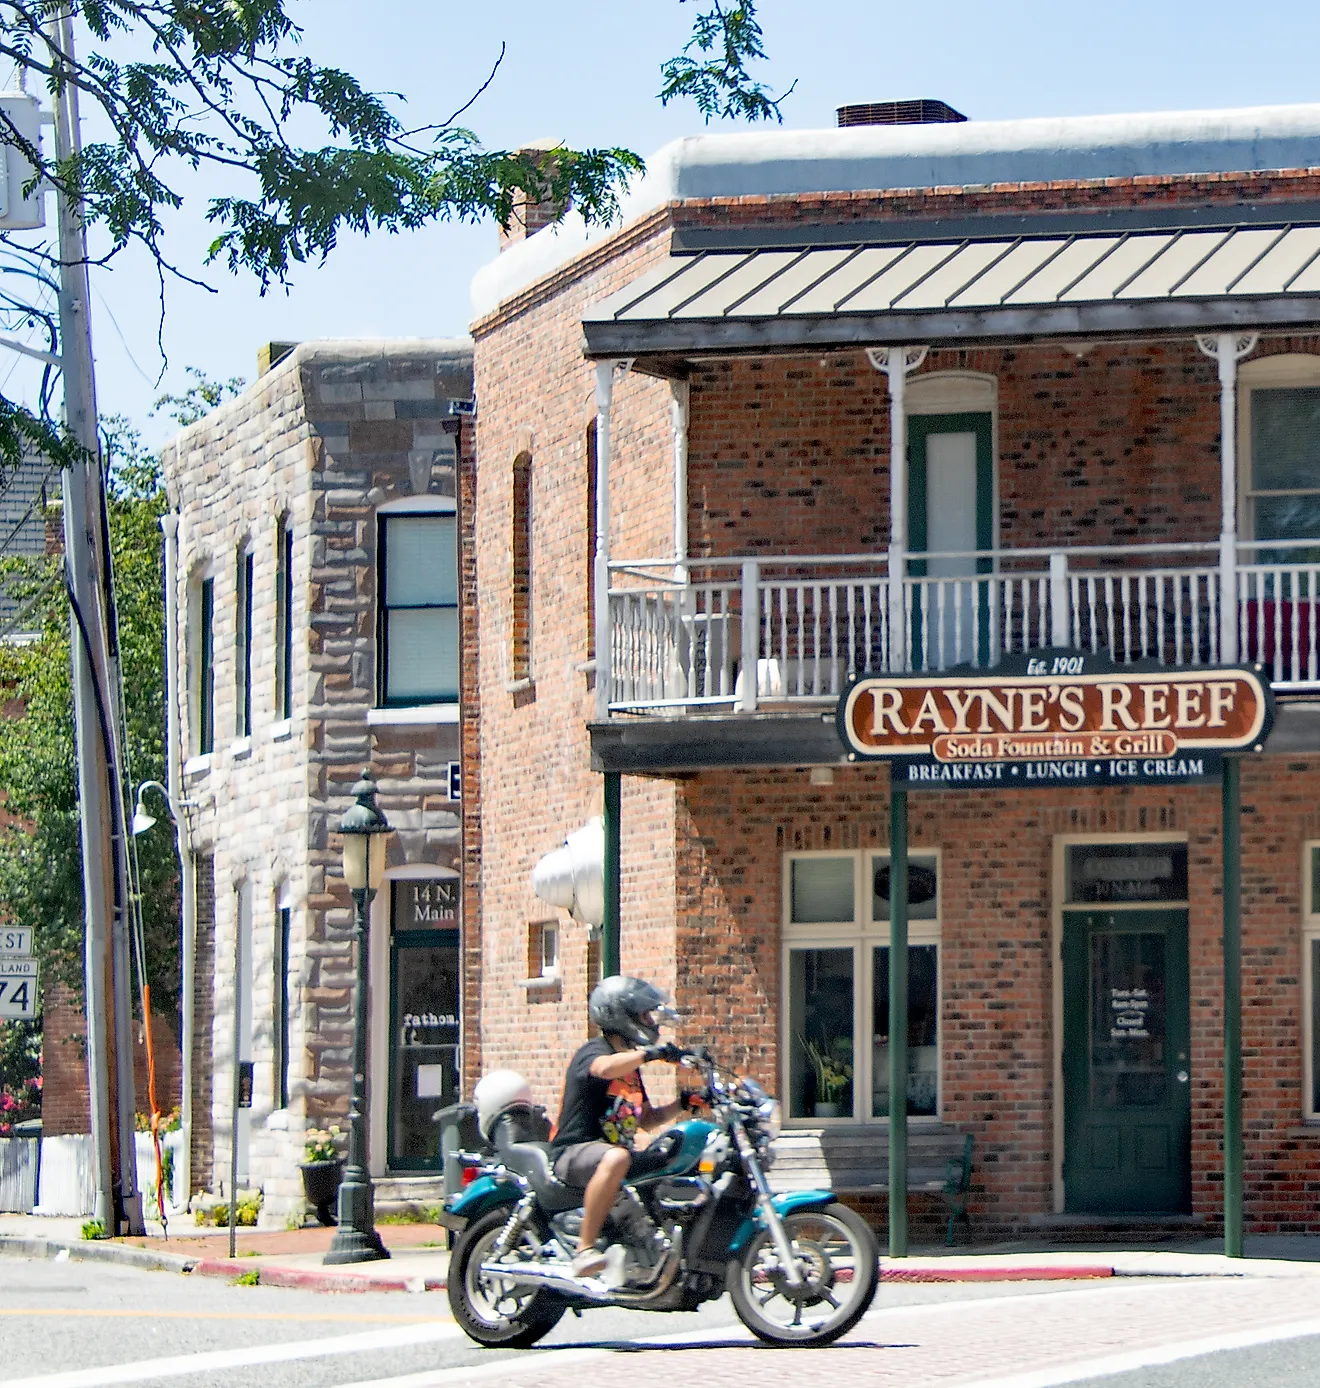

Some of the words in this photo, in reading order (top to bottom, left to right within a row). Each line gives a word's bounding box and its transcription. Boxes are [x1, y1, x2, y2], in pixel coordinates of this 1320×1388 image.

[1051, 657, 1084, 675] 1901
[868, 685, 1086, 736] RAYNE'S
[1096, 682, 1237, 731] REEF
[946, 738, 993, 758] Soda
[998, 736, 1084, 757] Fountain
[1090, 735, 1111, 755] &
[1115, 734, 1163, 755] Grill
[909, 763, 1004, 781] BREAKFAST
[1026, 761, 1087, 779] LUNCH
[1109, 760, 1138, 776] ICE
[1143, 758, 1203, 775] CREAM
[414, 884, 431, 901] 14
[436, 884, 456, 902] N.
[414, 904, 455, 921] Main
[0, 932, 24, 949] ST
[404, 1012, 459, 1026] fathom.
